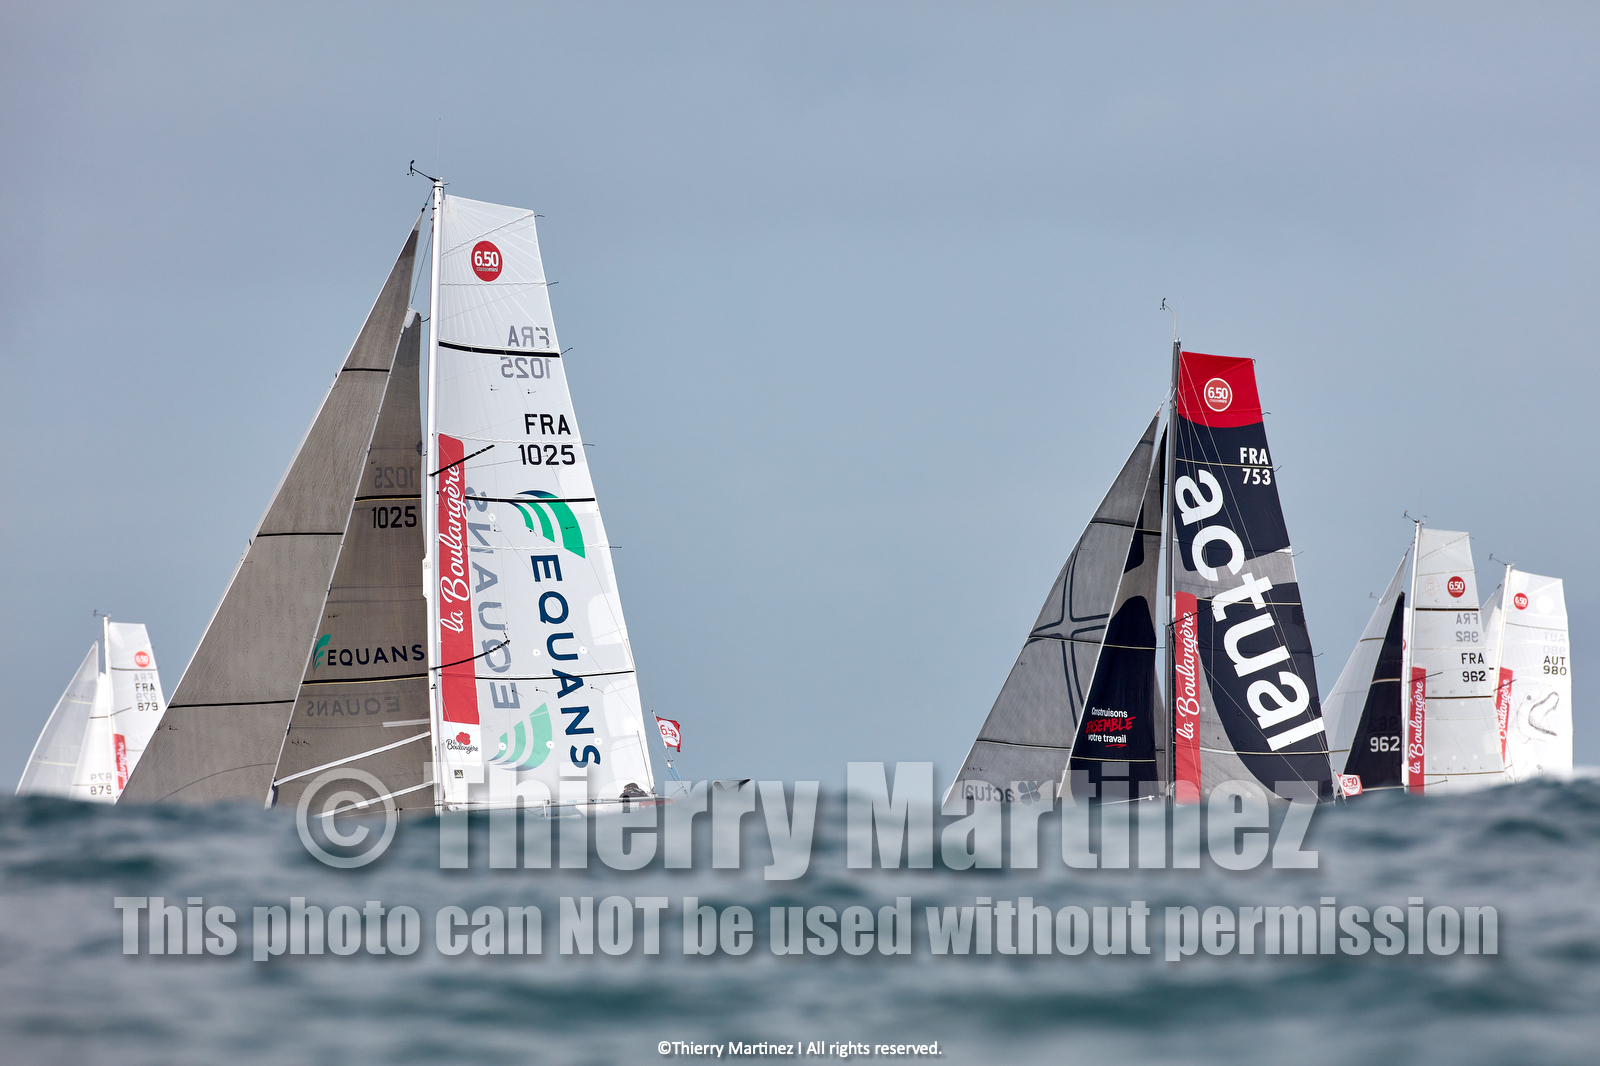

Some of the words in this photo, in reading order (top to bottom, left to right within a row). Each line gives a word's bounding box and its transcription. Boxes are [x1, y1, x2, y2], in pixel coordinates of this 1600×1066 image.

[474, 250, 499, 267] 6.50
[1208, 386, 1228, 400] 6.50
[525, 414, 571, 435] FRA
[518, 445, 576, 466] 1025
[1239, 447, 1269, 465] FRA
[1242, 468, 1272, 485] 753
[371, 505, 417, 529] 1025
[438, 464, 471, 604] Boulangère
[1449, 581, 1464, 591] 6.50
[1174, 469, 1325, 752] actual
[440, 610, 463, 633] la
[328, 644, 425, 666] EQUANS
[530, 554, 602, 769] EQUANS
[1461, 652, 1485, 664] FRA
[1543, 655, 1566, 666] AUT
[1175, 611, 1200, 718] Boulangère
[1543, 665, 1567, 676] 980
[1462, 670, 1487, 682] 962
[135, 683, 156, 692] FRA
[137, 702, 159, 711] 879
[1408, 681, 1427, 762] Boulangère
[1102, 734, 1127, 743] travail
[1176, 721, 1194, 740] la
[1370, 736, 1400, 752] 962
[1410, 761, 1422, 774] la
[90, 785, 112, 795] 879
